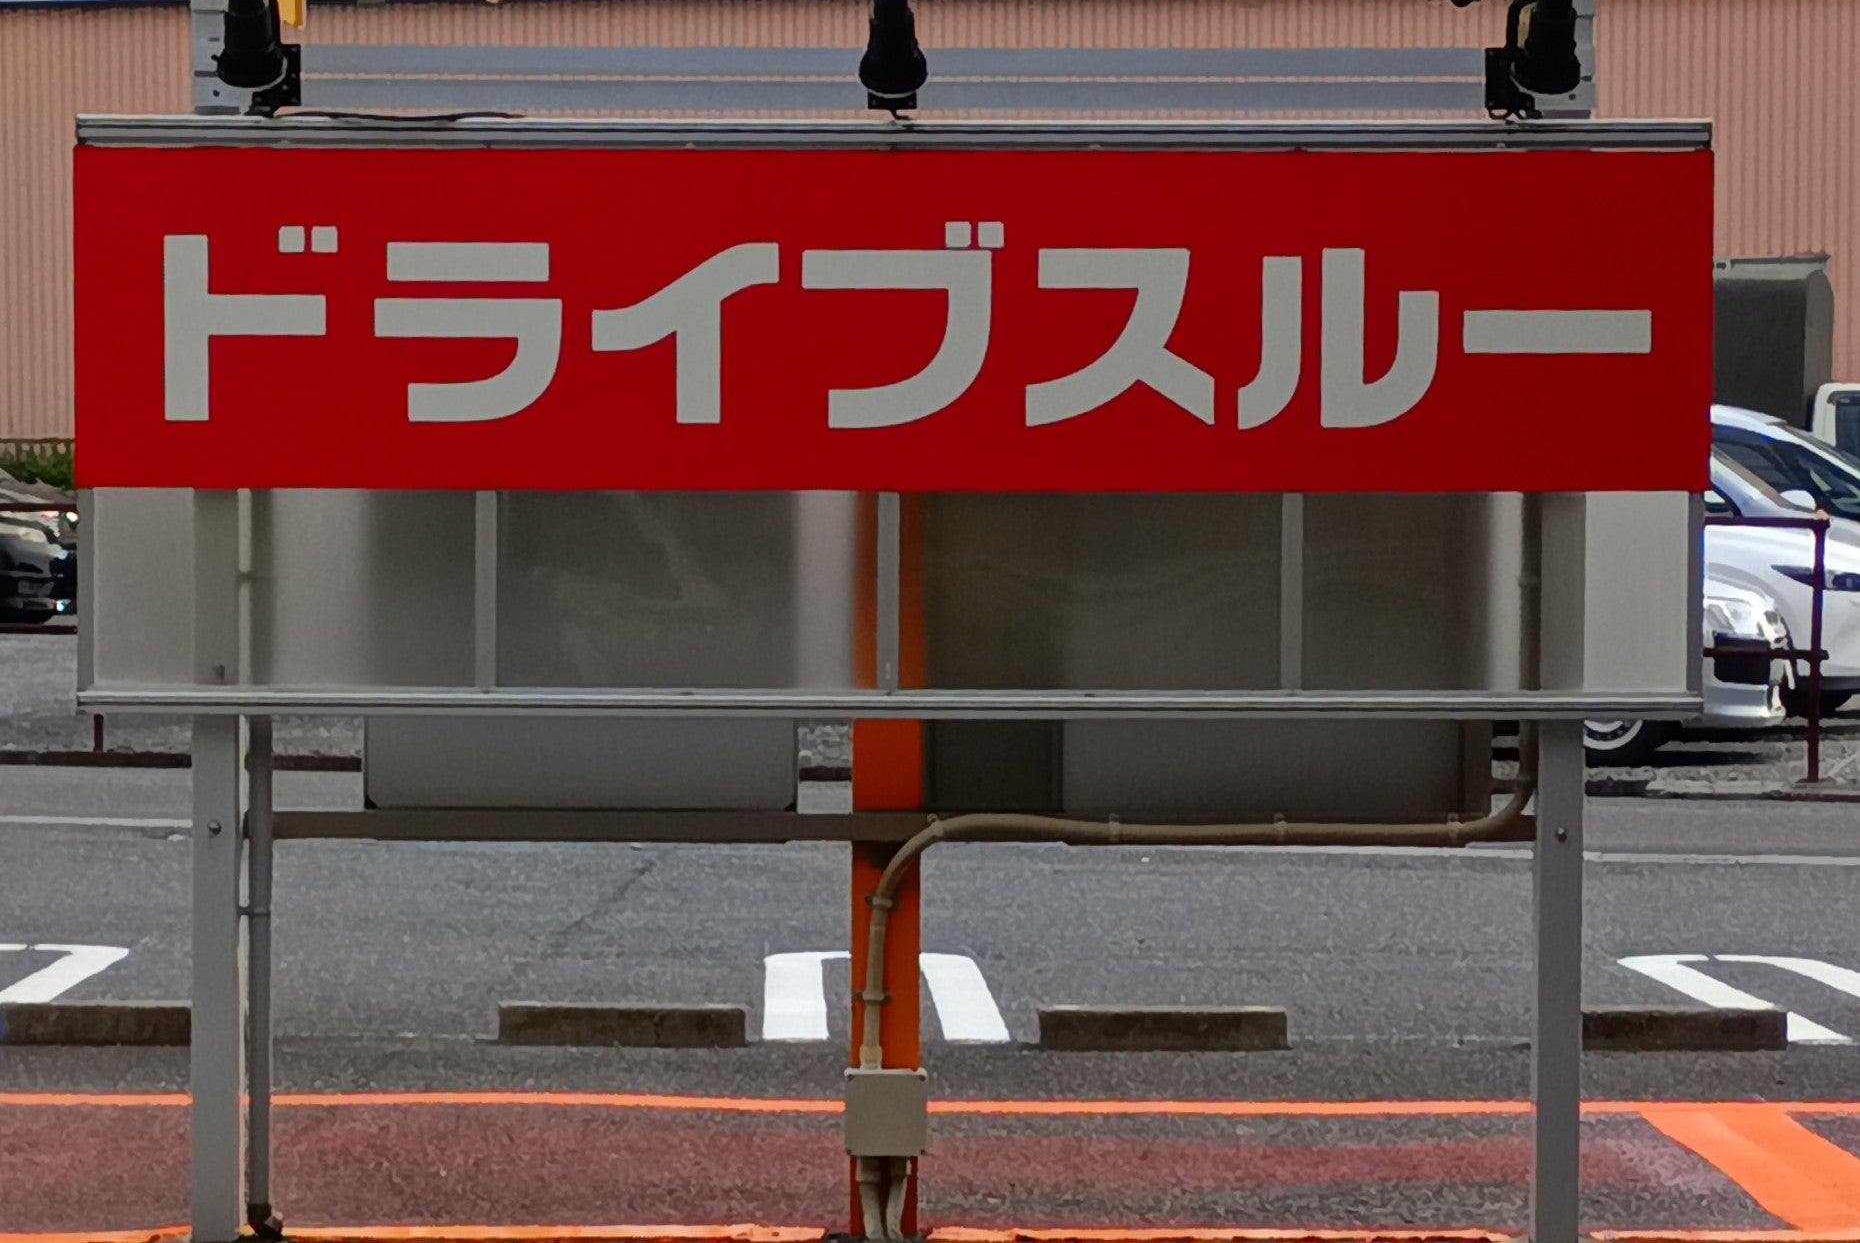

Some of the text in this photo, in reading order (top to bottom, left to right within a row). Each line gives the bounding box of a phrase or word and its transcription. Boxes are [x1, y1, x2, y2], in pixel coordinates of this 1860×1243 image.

[163, 222, 1652, 429] ドライブスルー
